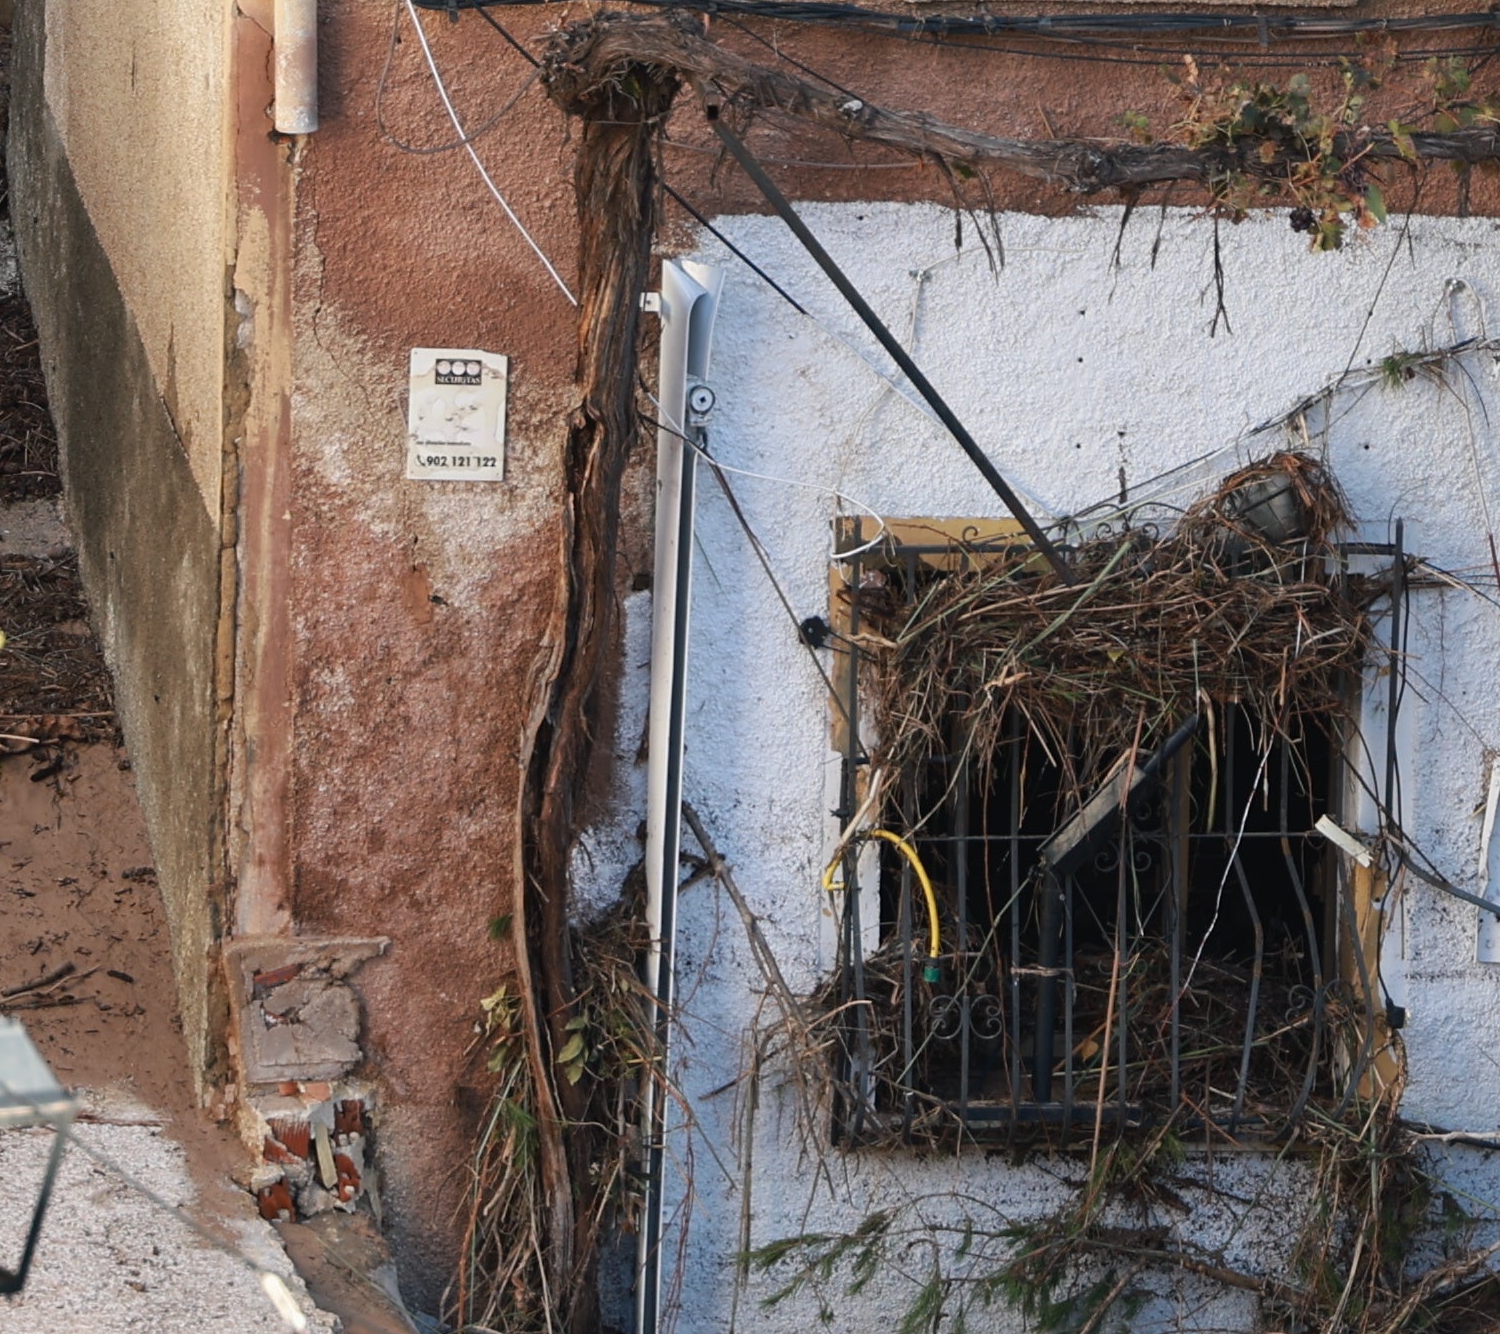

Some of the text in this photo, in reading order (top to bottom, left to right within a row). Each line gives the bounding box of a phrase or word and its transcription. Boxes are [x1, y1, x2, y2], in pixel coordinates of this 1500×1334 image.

[436, 375, 481, 384] SECURITAS
[426, 455, 497, 468] 902 121 122
